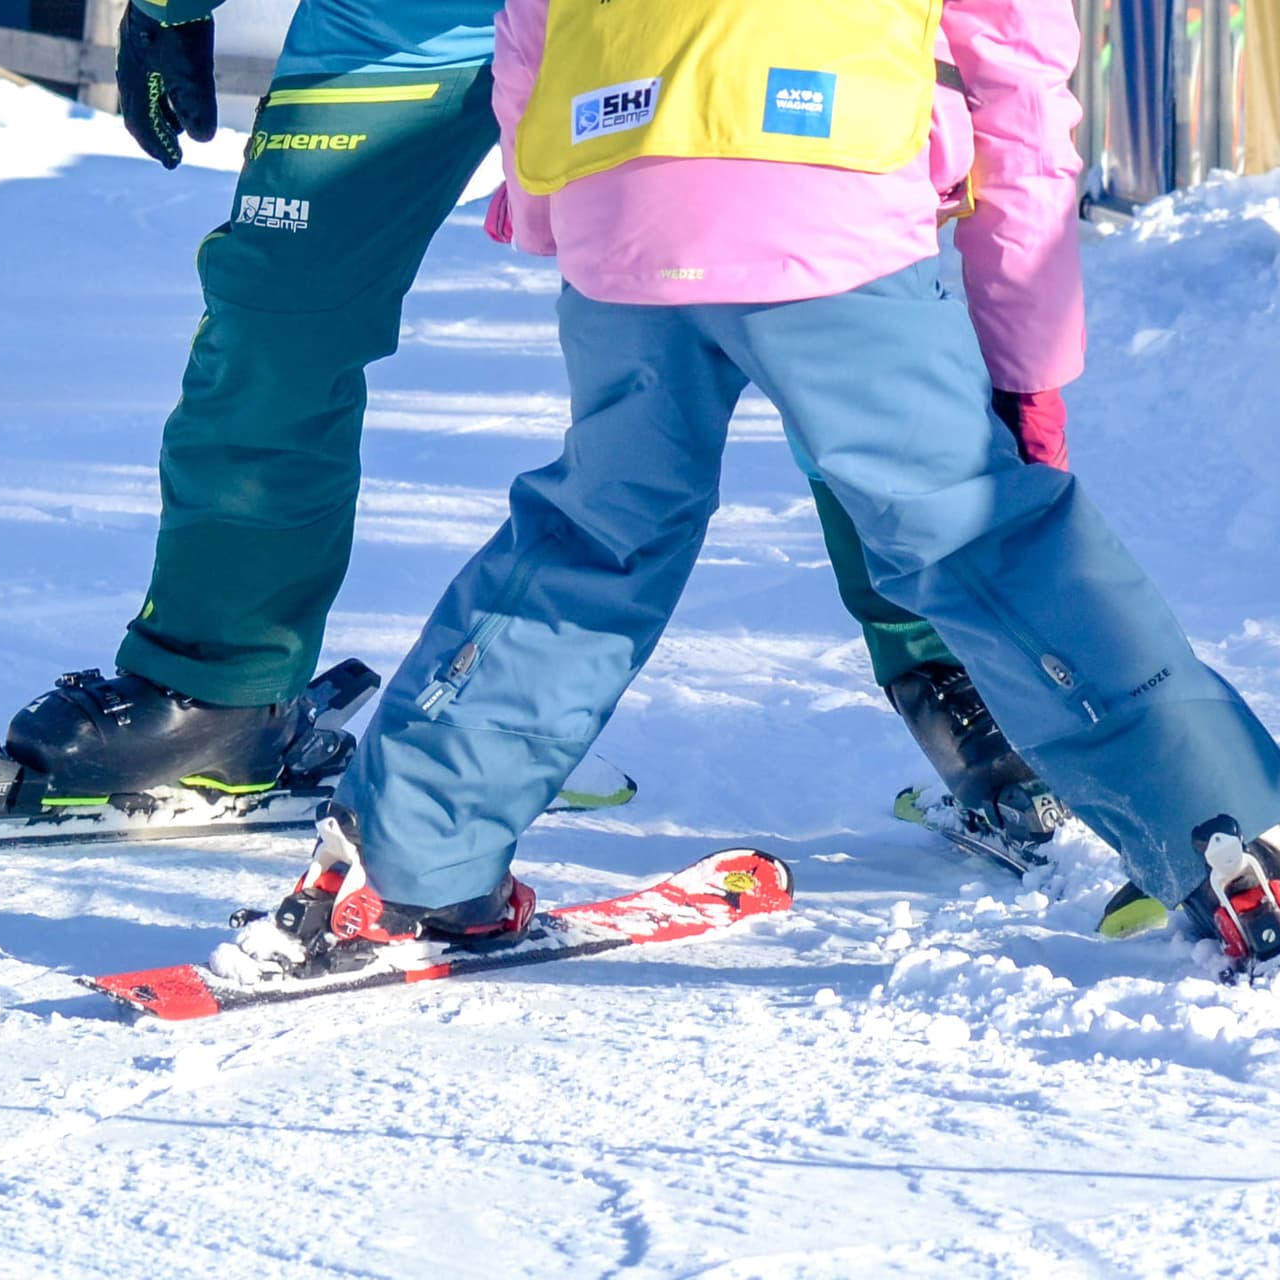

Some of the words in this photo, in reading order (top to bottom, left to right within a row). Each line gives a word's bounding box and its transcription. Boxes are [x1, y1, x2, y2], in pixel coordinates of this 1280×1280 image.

[603, 87, 652, 116] SKI
[601, 109, 650, 129] camp
[266, 133, 367, 150] ziener
[258, 196, 310, 220] SKI
[254, 216, 308, 233] camp
[1129, 667, 1172, 697] WEDZE
